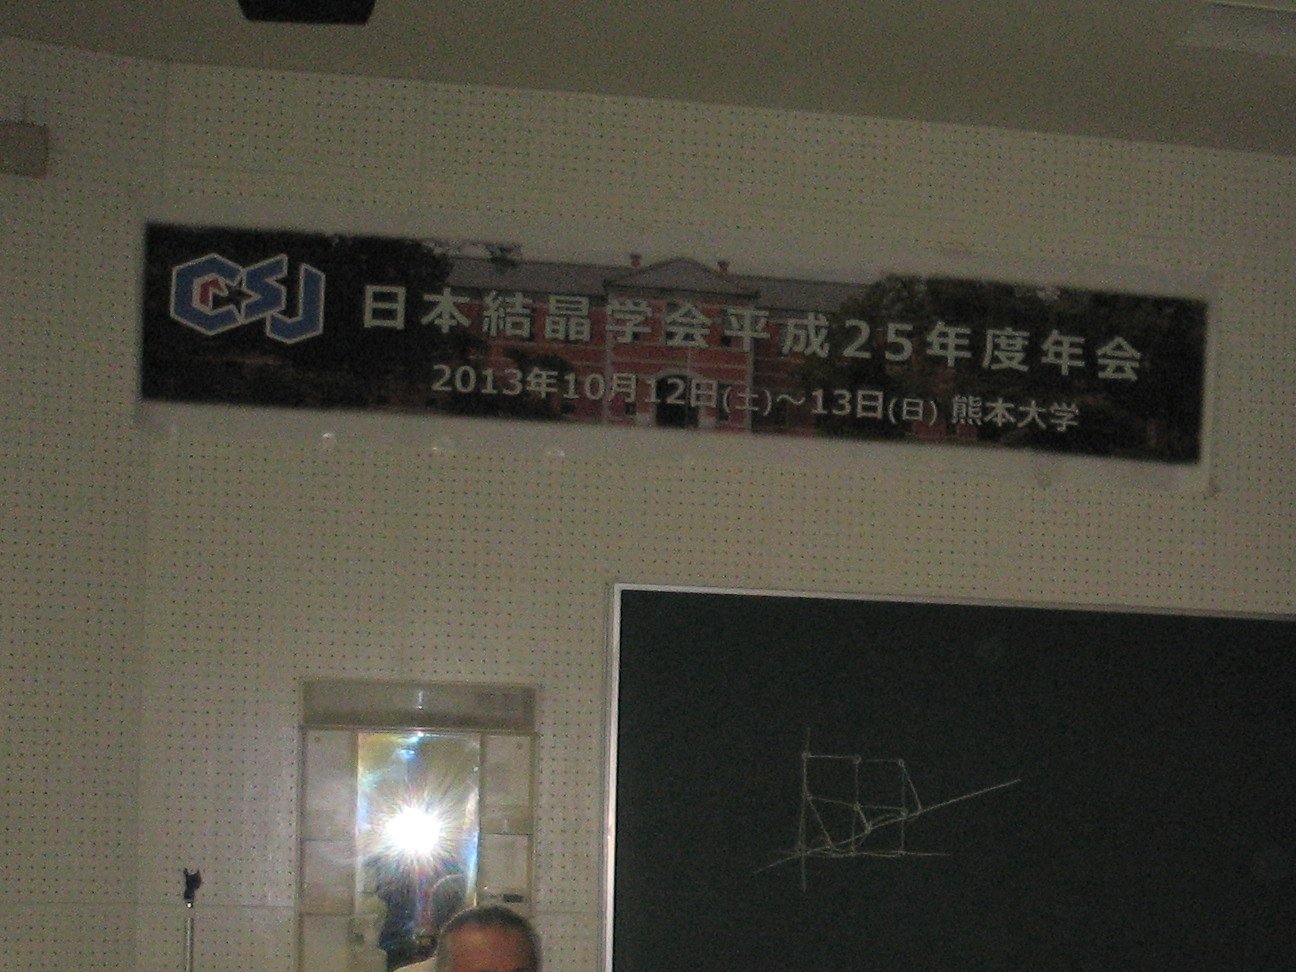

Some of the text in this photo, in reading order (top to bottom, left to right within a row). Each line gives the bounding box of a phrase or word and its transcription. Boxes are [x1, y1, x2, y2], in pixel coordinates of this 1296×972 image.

[170, 253, 325, 344] CSJ
[363, 284, 1142, 382] 日本結晶学会平成25年度年会
[951, 395, 1080, 433] 熊本大学
